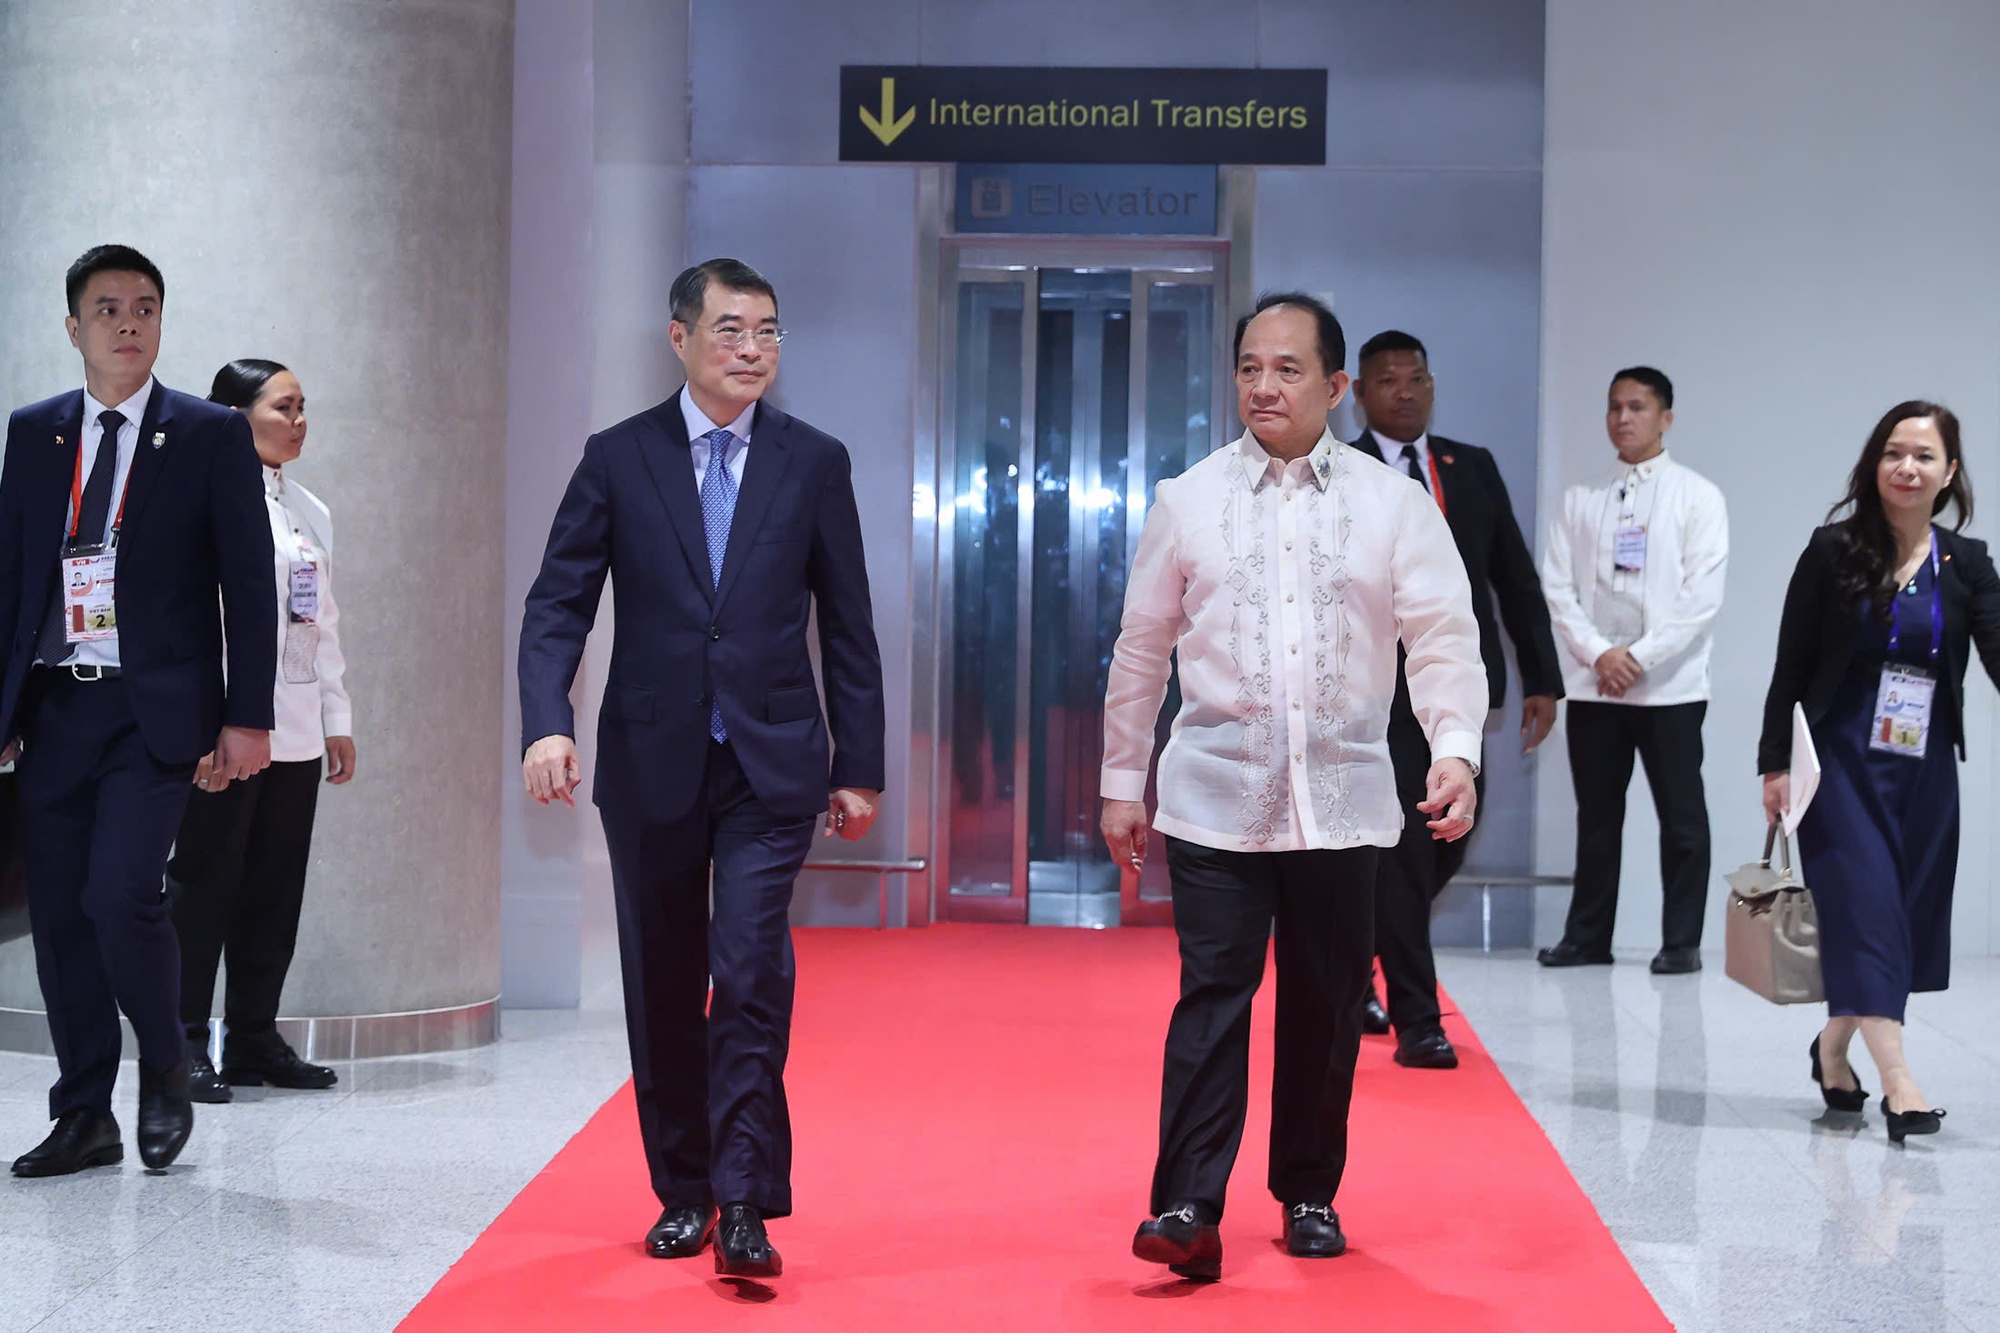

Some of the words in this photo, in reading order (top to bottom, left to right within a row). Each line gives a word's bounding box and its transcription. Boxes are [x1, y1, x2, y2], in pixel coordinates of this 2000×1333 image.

[929, 97, 1140, 128] International
[1150, 98, 1309, 131] Transfers
[1027, 182, 1198, 218] Elevator
[96, 614, 106, 628] 2
[1902, 731, 1907, 744] 1
